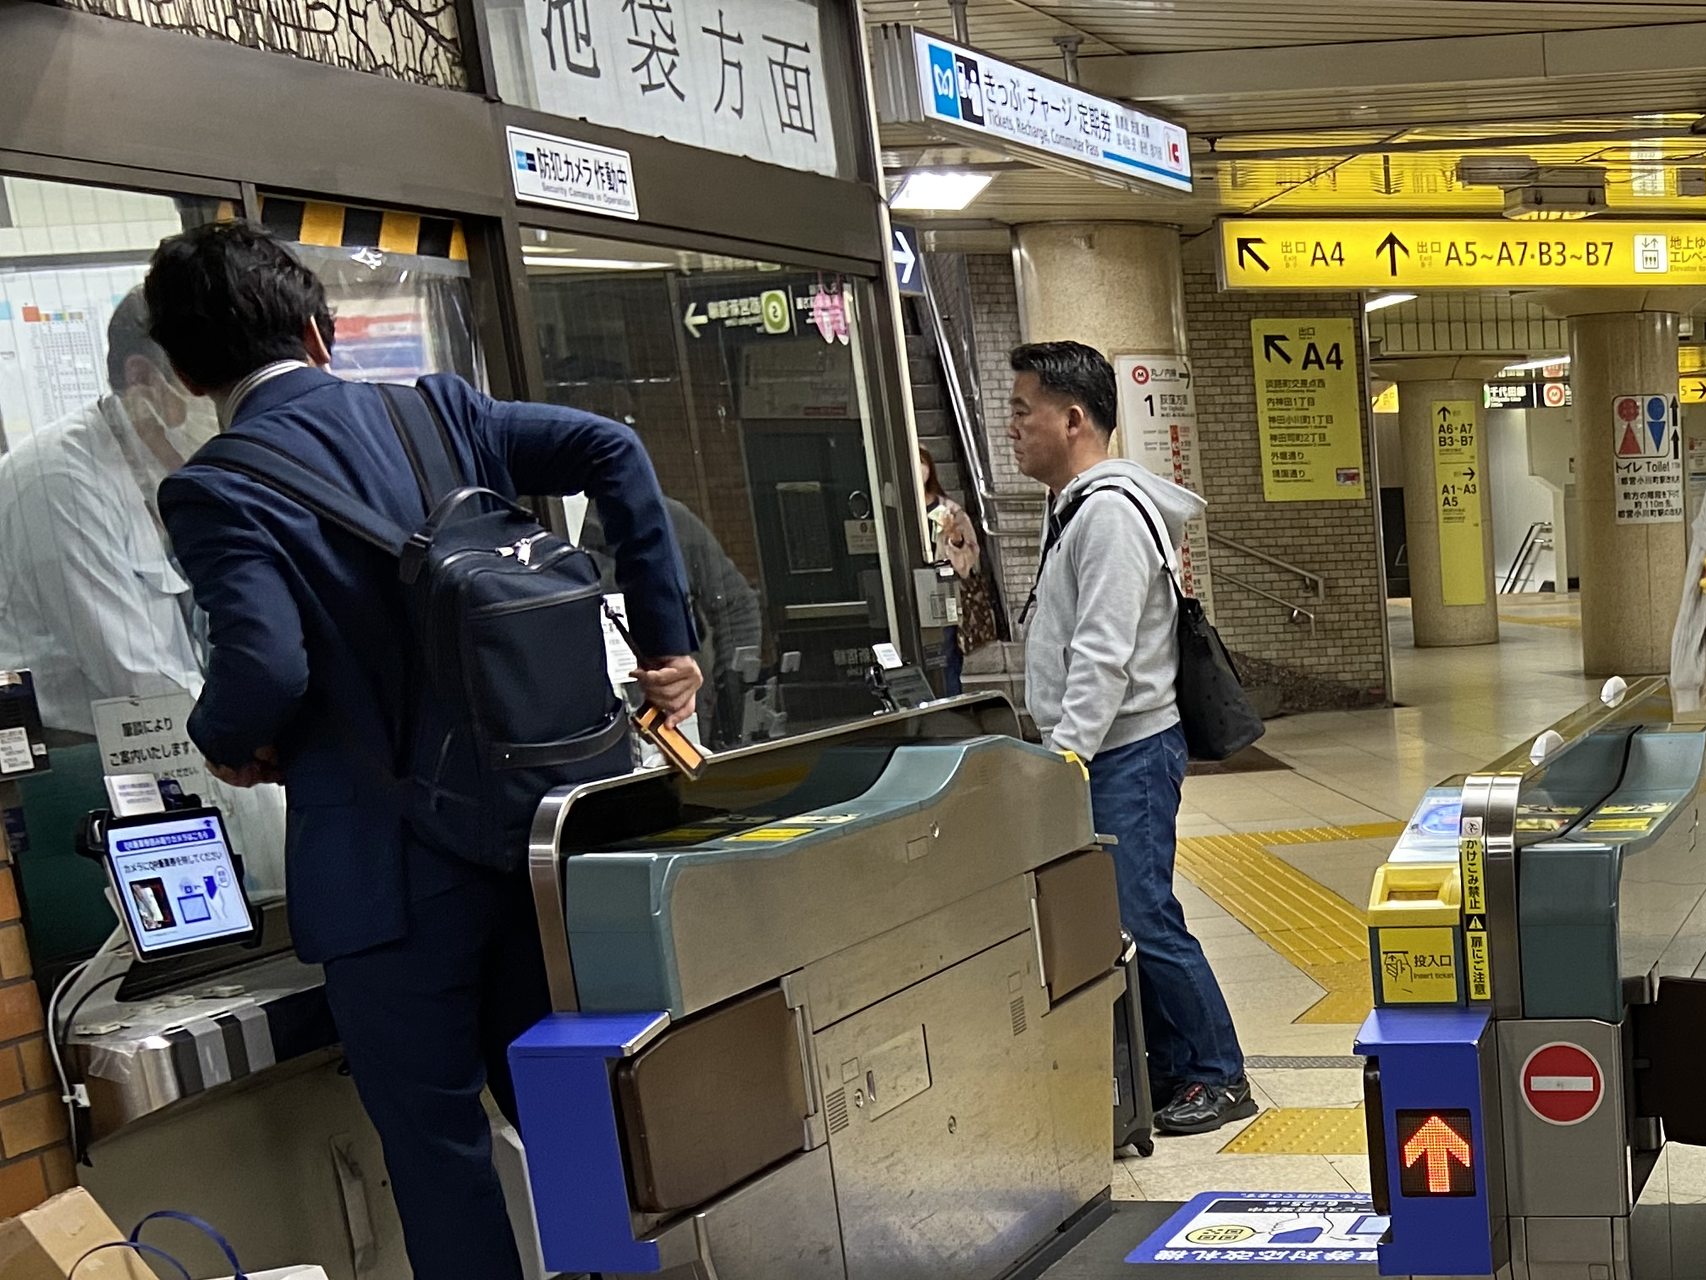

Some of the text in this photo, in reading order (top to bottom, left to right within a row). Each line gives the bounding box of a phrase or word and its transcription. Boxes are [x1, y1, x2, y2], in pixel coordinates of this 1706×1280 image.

[541, 0, 818, 143] 池袋方面
[537, 147, 628, 196] 防犯カメラ作動中
[1281, 241, 1306, 253] 出口
[1310, 242, 1345, 267] A4
[1416, 241, 1441, 253] 出口
[1302, 343, 1344, 370] A4
[1144, 394, 1154, 417] 1
[1616, 461, 1643, 474] トイレ
[1646, 461, 1670, 472] Toilet
[1443, 497, 1459, 507] A5
[1466, 839, 1482, 911] かけこみ禁止
[1414, 954, 1452, 968] 投入口
[1470, 935, 1487, 996] 扉にご注意
[1413, 971, 1455, 980] Insert ticket
